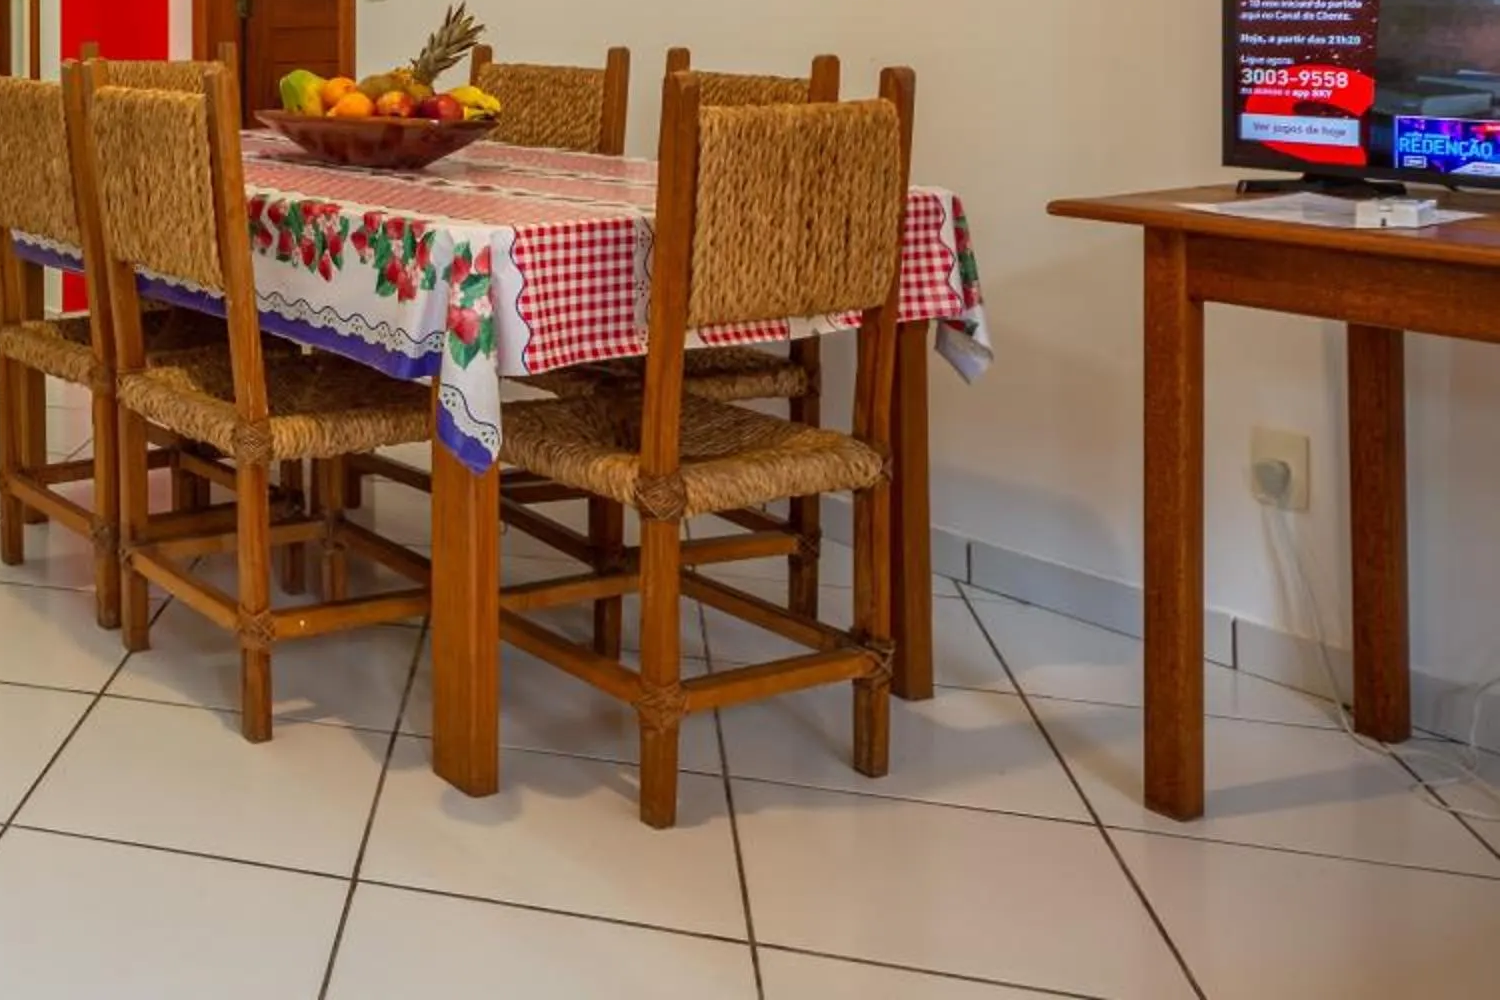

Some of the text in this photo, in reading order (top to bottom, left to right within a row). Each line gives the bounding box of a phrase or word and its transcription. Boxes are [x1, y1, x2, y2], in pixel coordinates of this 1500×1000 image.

[1241, 67, 1349, 89] 3003-9558
[1253, 121, 1270, 132] Ver
[1399, 136, 1493, 160] REDENÇÃO
